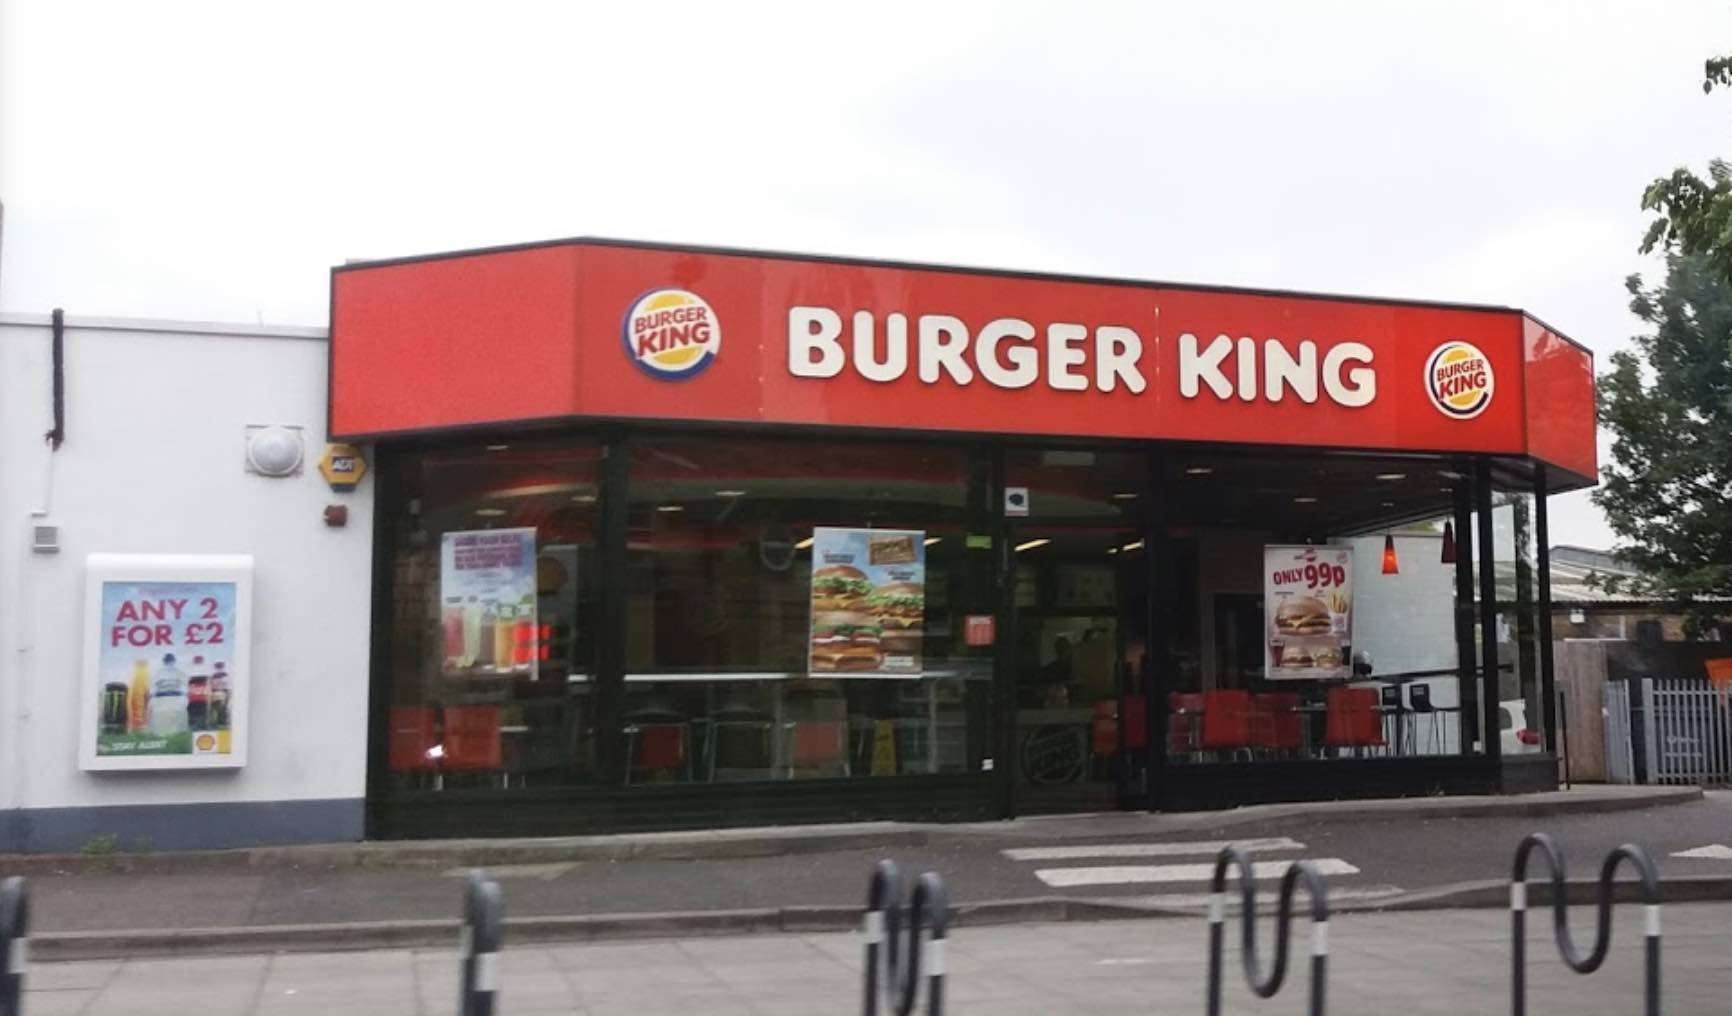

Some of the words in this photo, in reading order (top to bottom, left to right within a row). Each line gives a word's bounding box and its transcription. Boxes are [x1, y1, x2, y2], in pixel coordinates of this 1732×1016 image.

[635, 306, 707, 334] BURGER
[638, 322, 710, 357] KING
[788, 306, 1146, 395] BURGER
[1178, 333, 1377, 407] KING
[1436, 358, 1483, 382] BURGER
[1440, 371, 1486, 399] KING
[1273, 567, 1303, 585] ONLY
[1304, 562, 1346, 589] 99p
[116, 599, 188, 622] ANY
[200, 597, 219, 620] 2
[111, 624, 173, 647] FOR
[184, 622, 224, 645] £2
